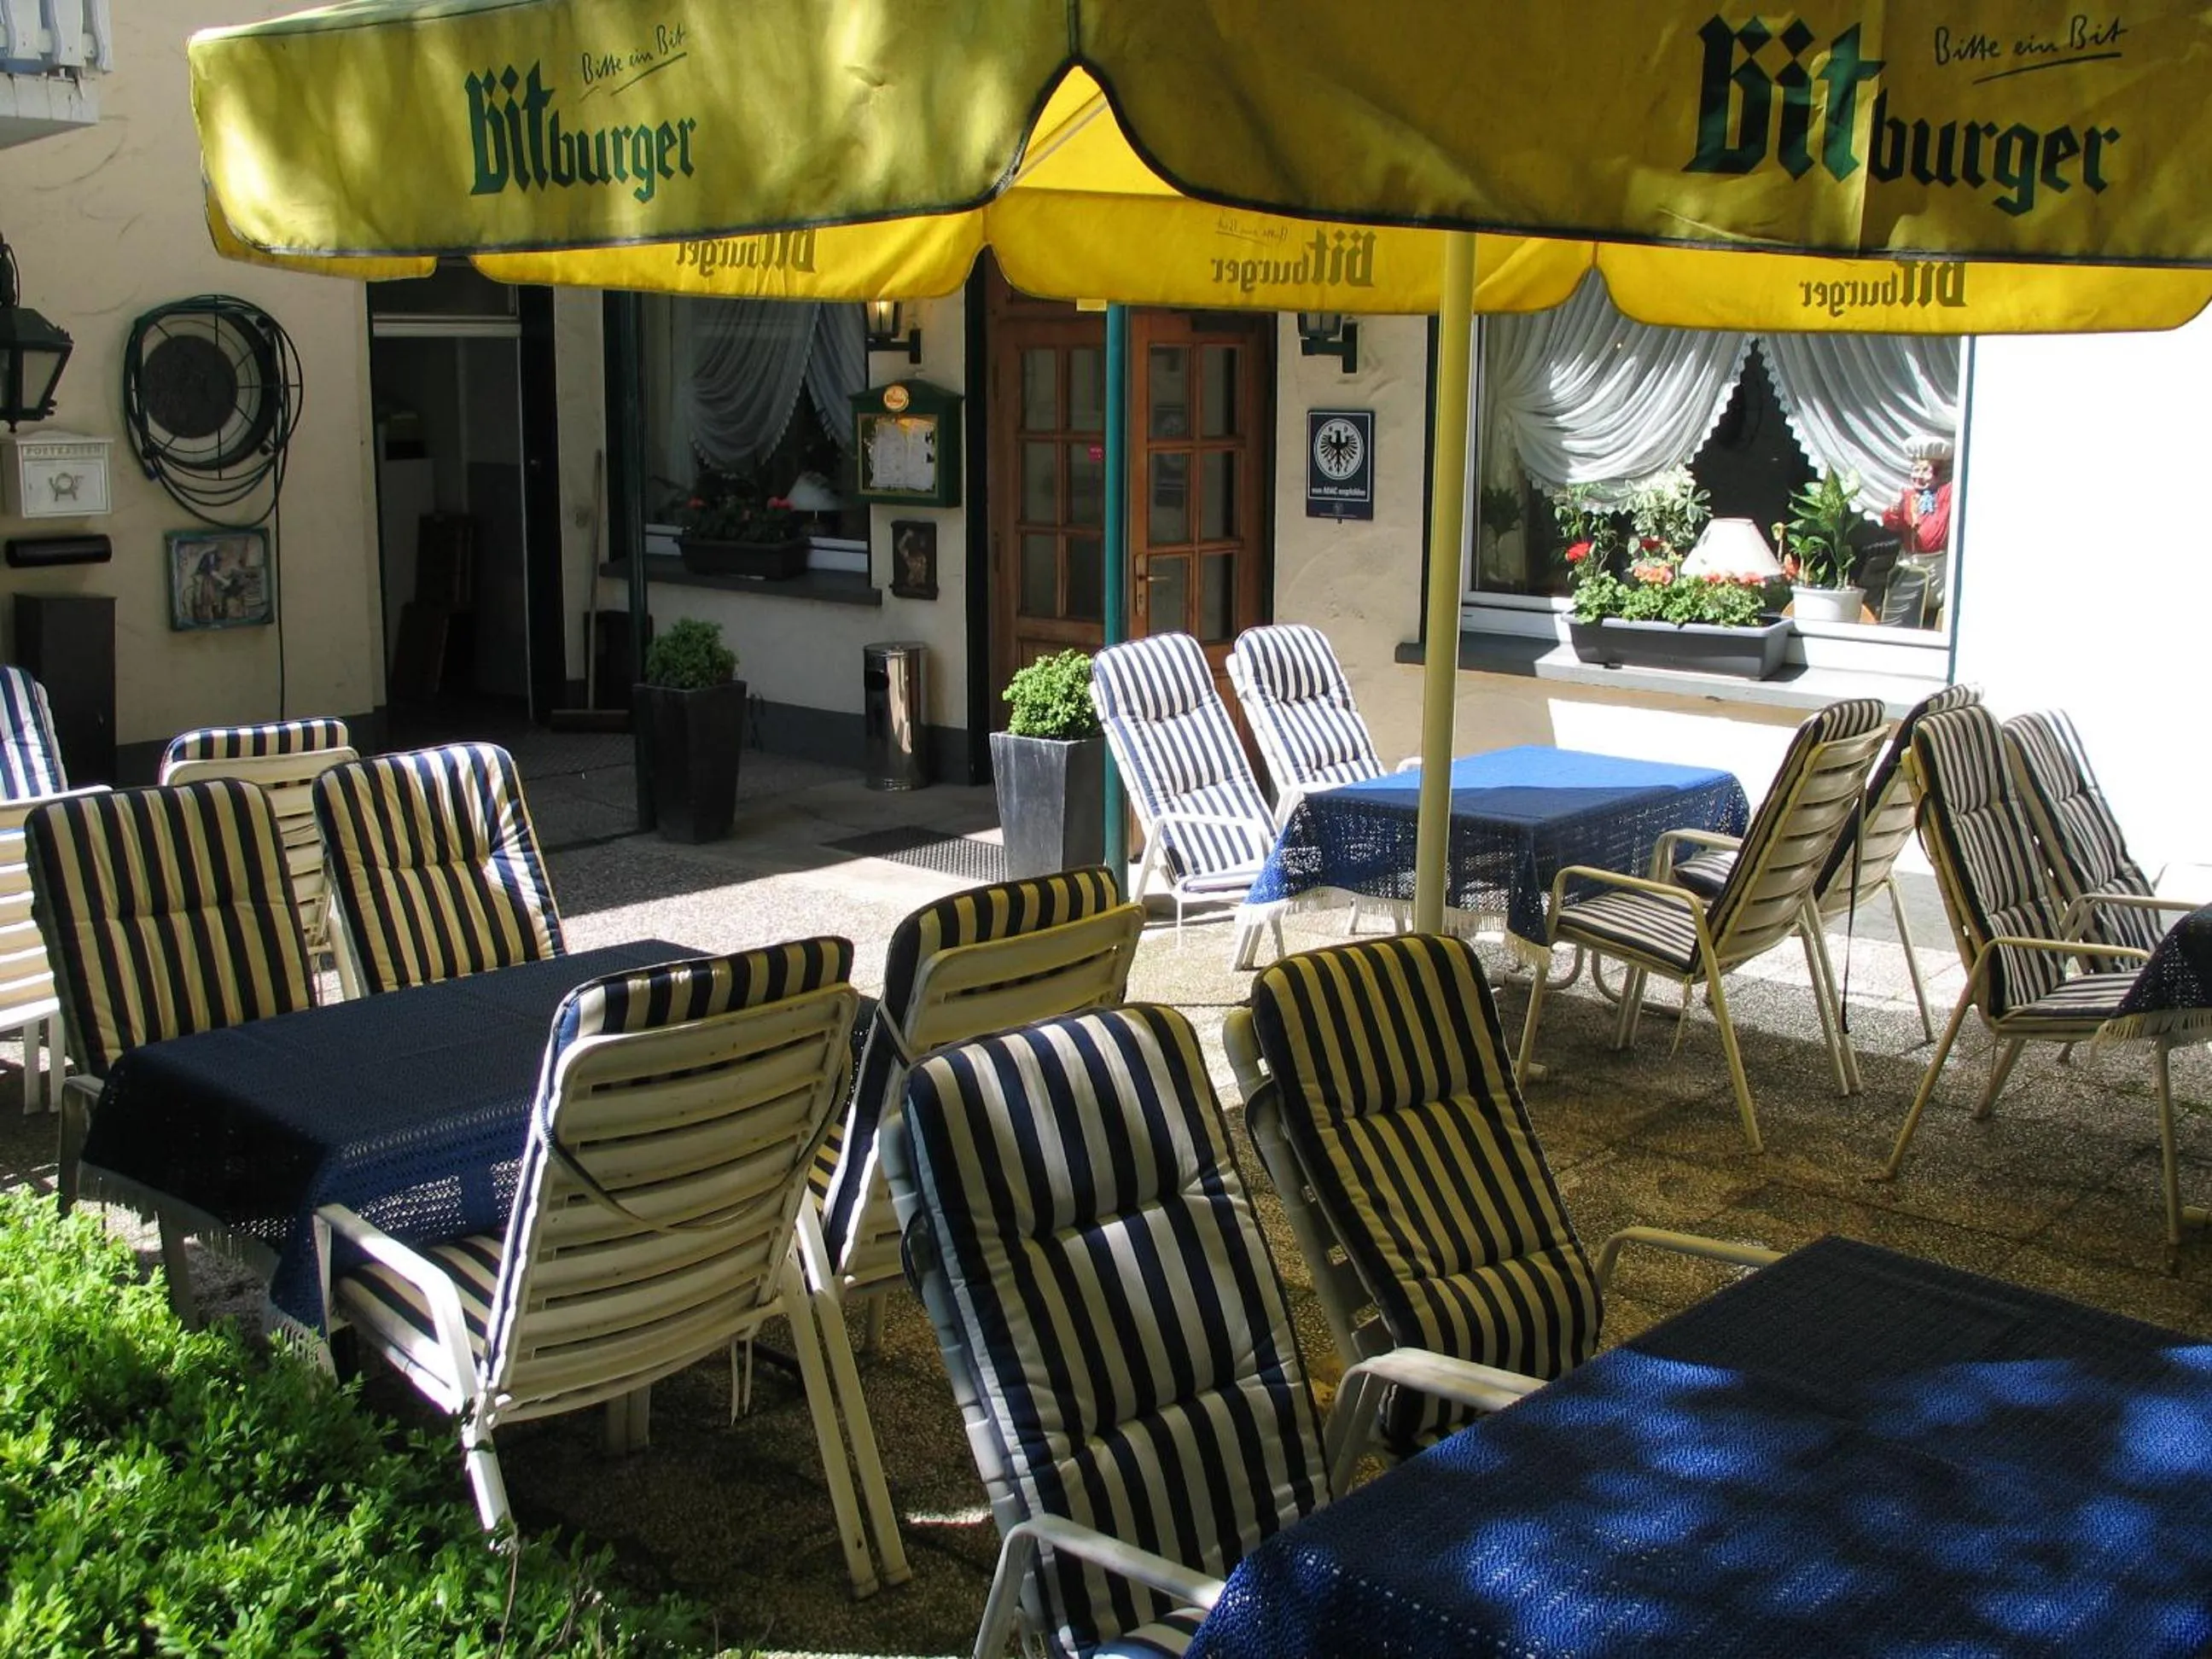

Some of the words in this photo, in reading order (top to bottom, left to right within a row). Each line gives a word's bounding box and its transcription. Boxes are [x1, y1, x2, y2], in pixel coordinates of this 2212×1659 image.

[582, 52, 624, 84] Bitte
[629, 48, 654, 67] ein
[655, 23, 686, 56] Bit
[1935, 26, 2000, 66] Bitte
[2014, 35, 2058, 55] ein
[2069, 15, 2128, 49] Bit
[464, 58, 697, 204] Bitburger
[1681, 14, 2121, 217] Bitburger
